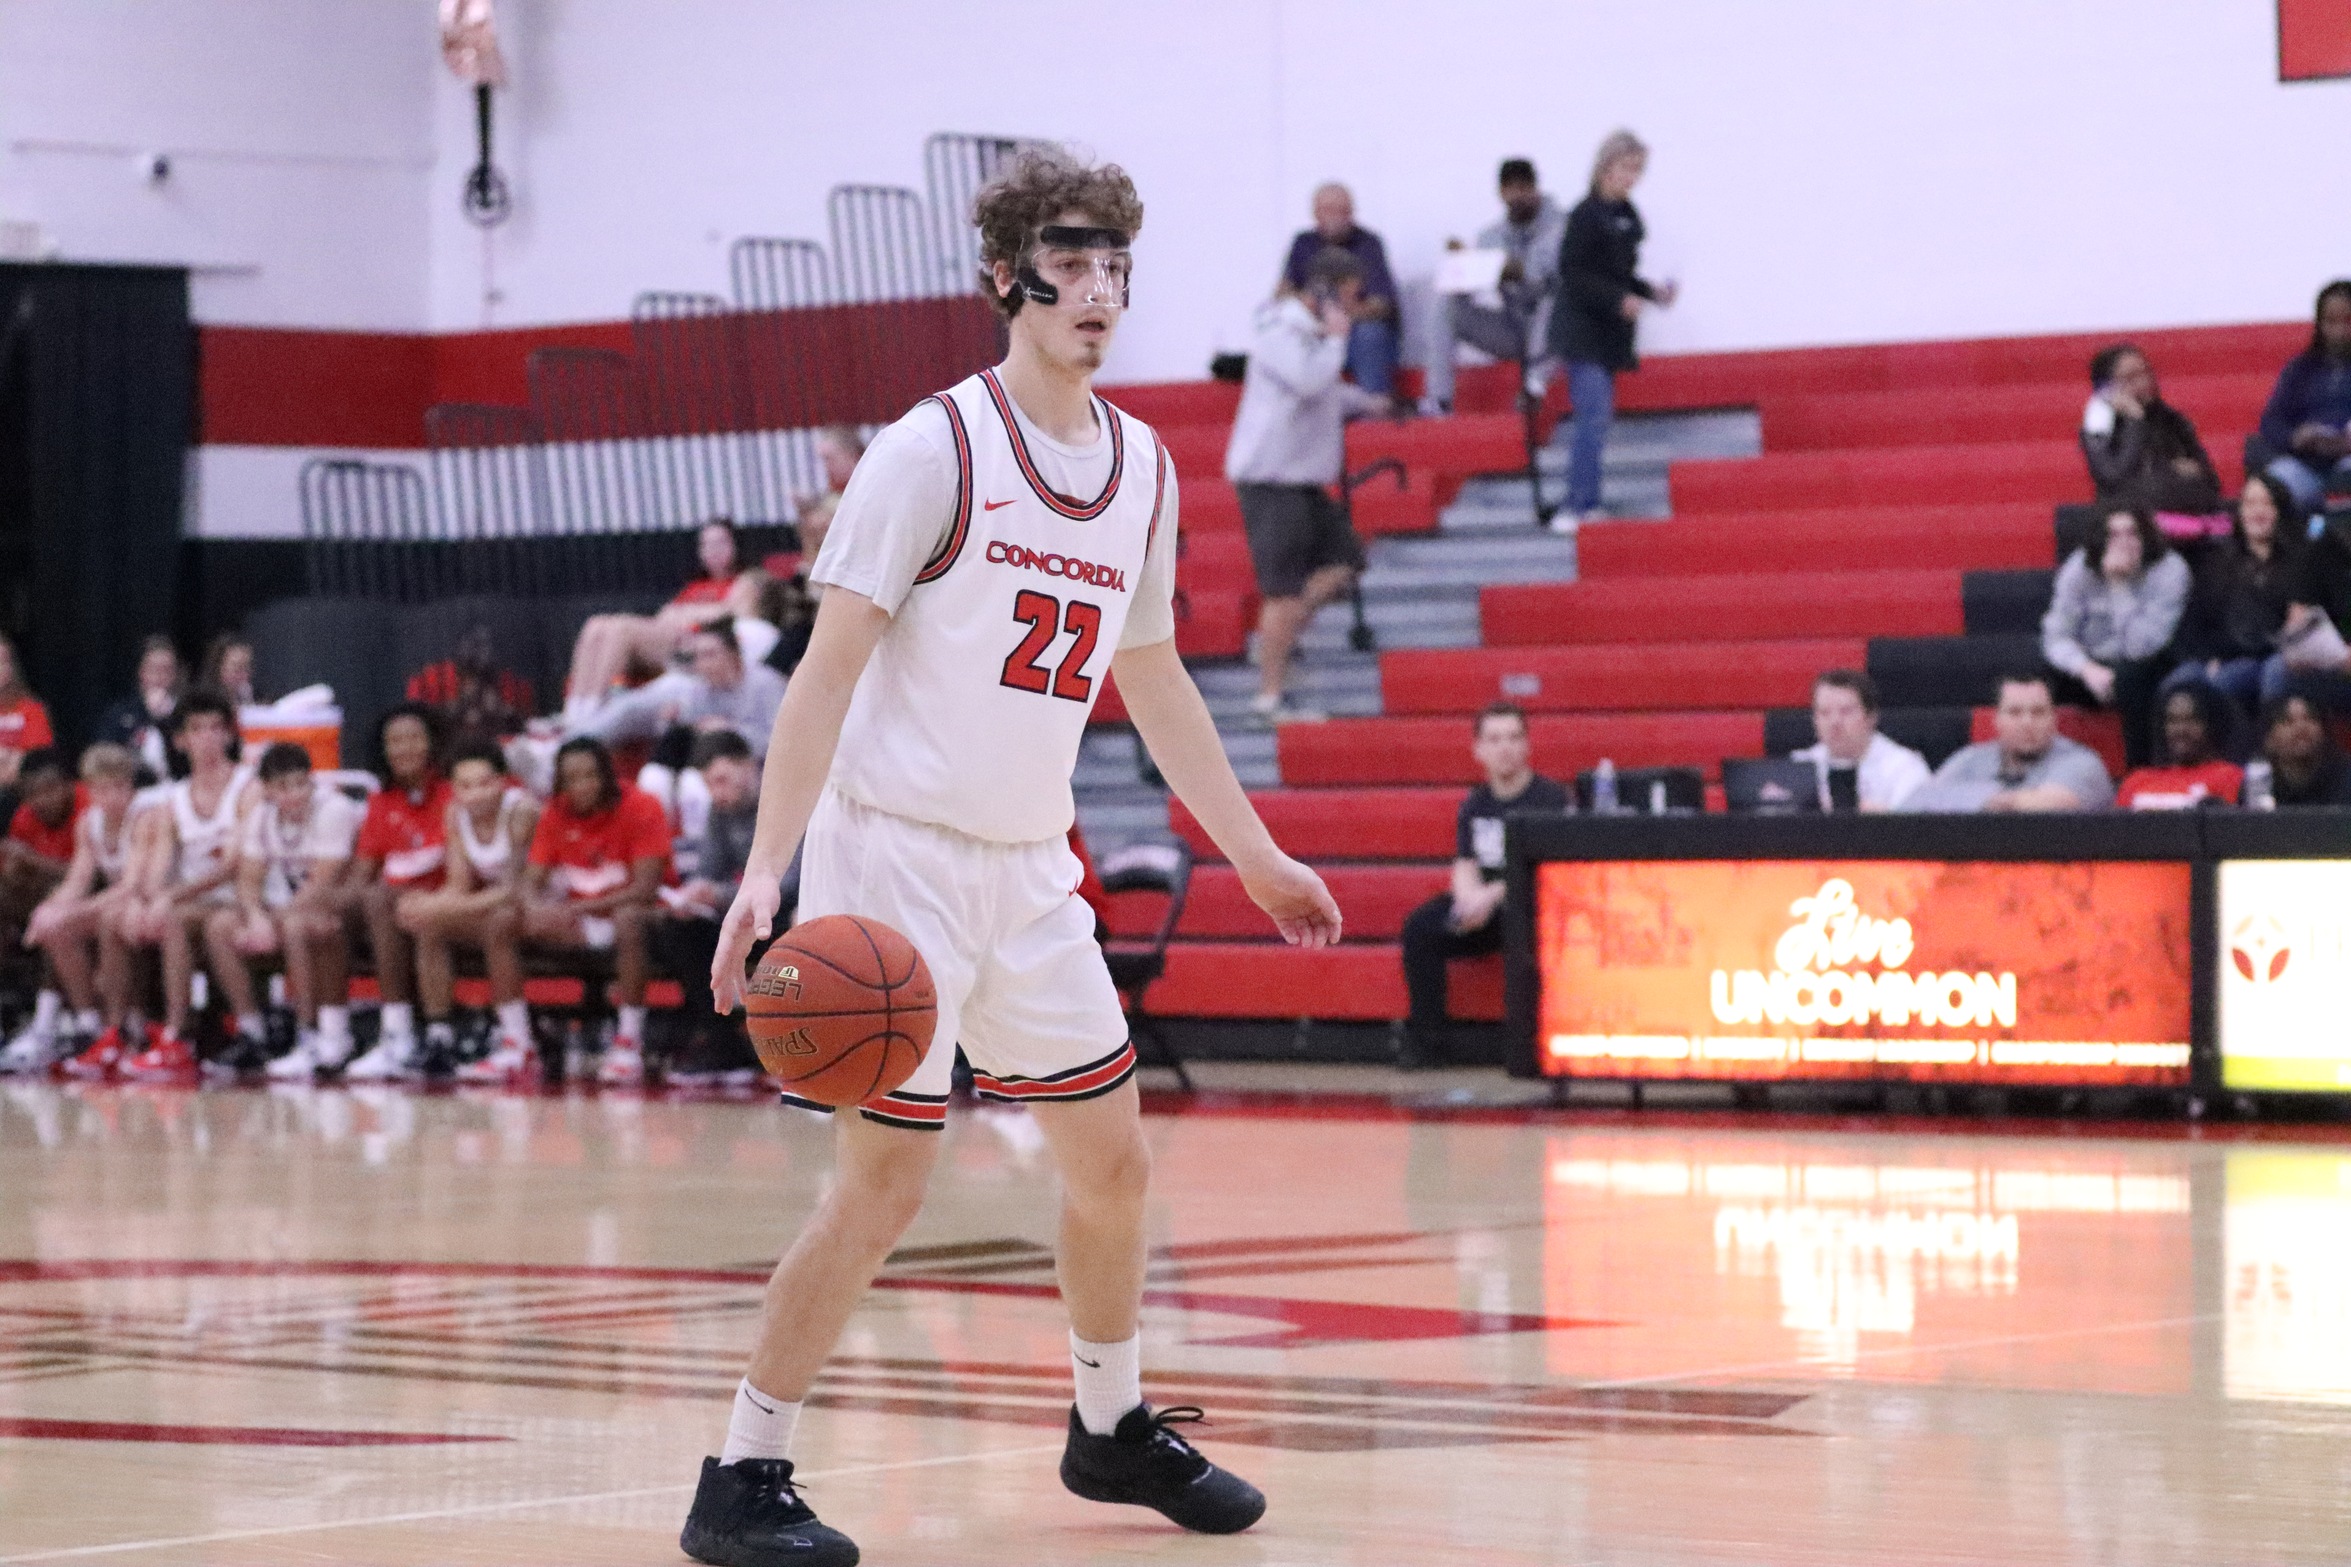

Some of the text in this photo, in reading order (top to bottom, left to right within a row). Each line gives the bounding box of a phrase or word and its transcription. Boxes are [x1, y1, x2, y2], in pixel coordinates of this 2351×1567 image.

[986, 540, 1126, 592] CONCORDIA
[1000, 589, 1102, 703] 22
[1711, 969, 2017, 1027] UNCOMMON
